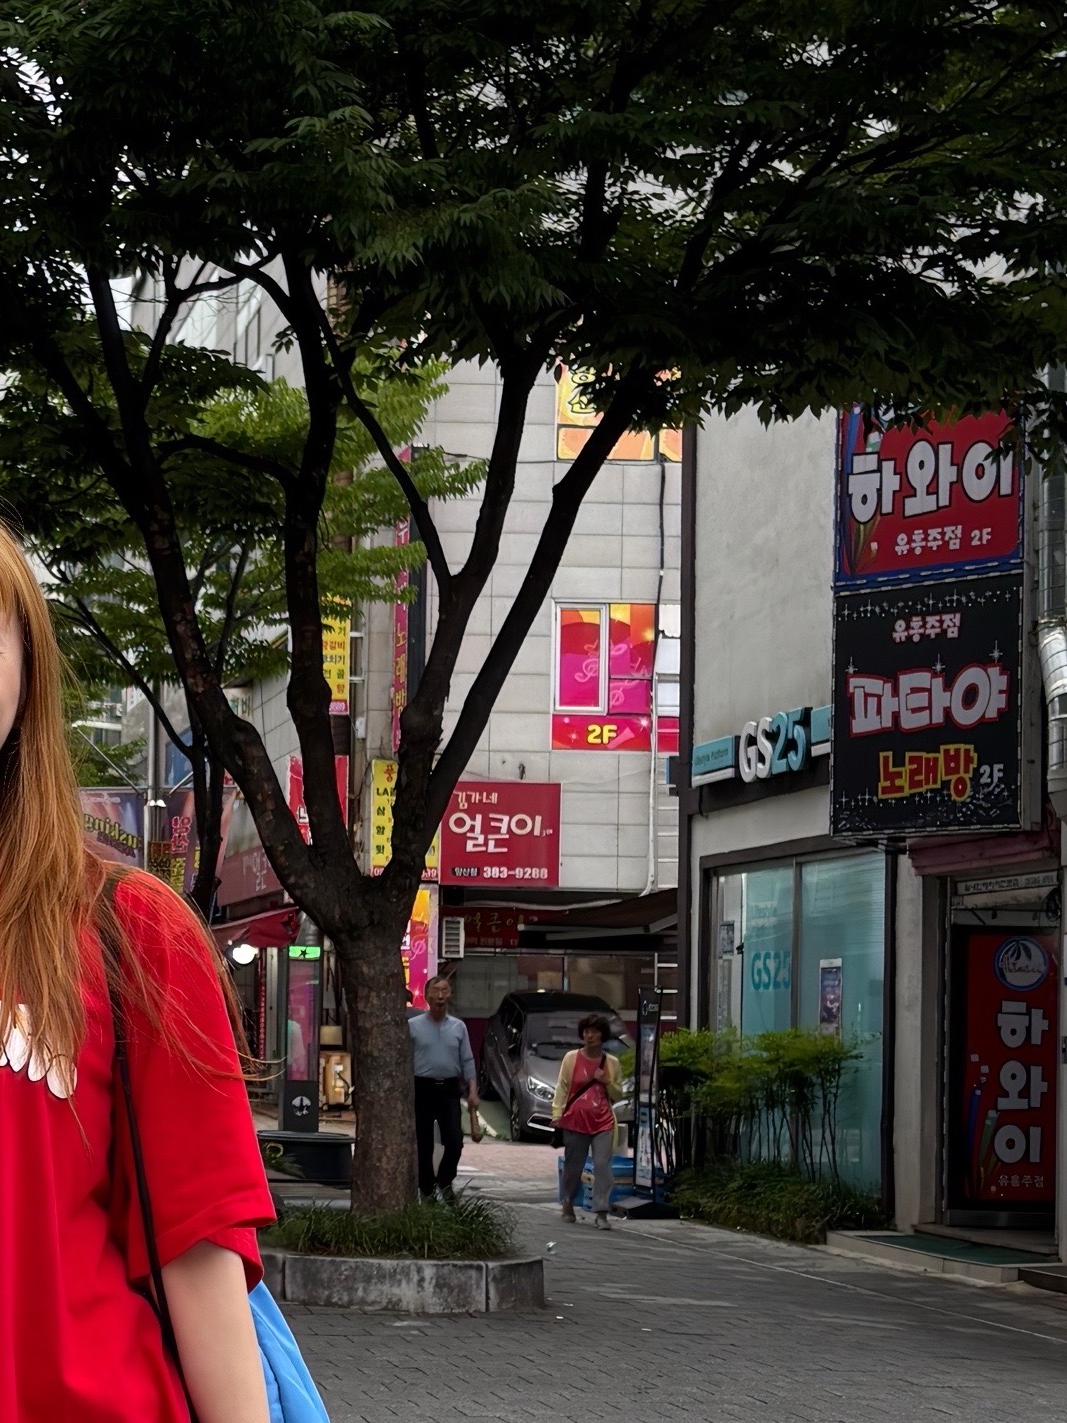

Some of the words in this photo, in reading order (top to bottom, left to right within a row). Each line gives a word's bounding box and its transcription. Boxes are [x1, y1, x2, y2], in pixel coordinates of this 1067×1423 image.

[848, 440, 1013, 524] 하와이
[895, 525, 962, 555] 유흥주점
[971, 527, 992, 546] 2F
[892, 613, 962, 643] 유흥주점
[847, 664, 1009, 736] 파타야
[587, 724, 618, 744] 2F
[739, 711, 806, 783] GS25
[878, 744, 977, 801] 노래방
[980, 764, 1004, 791] 2F
[453, 792, 498, 810] 김가네
[449, 812, 542, 853] 얼큰이
[752, 951, 791, 991] GS25
[994, 1001, 1049, 1164] 하와이
